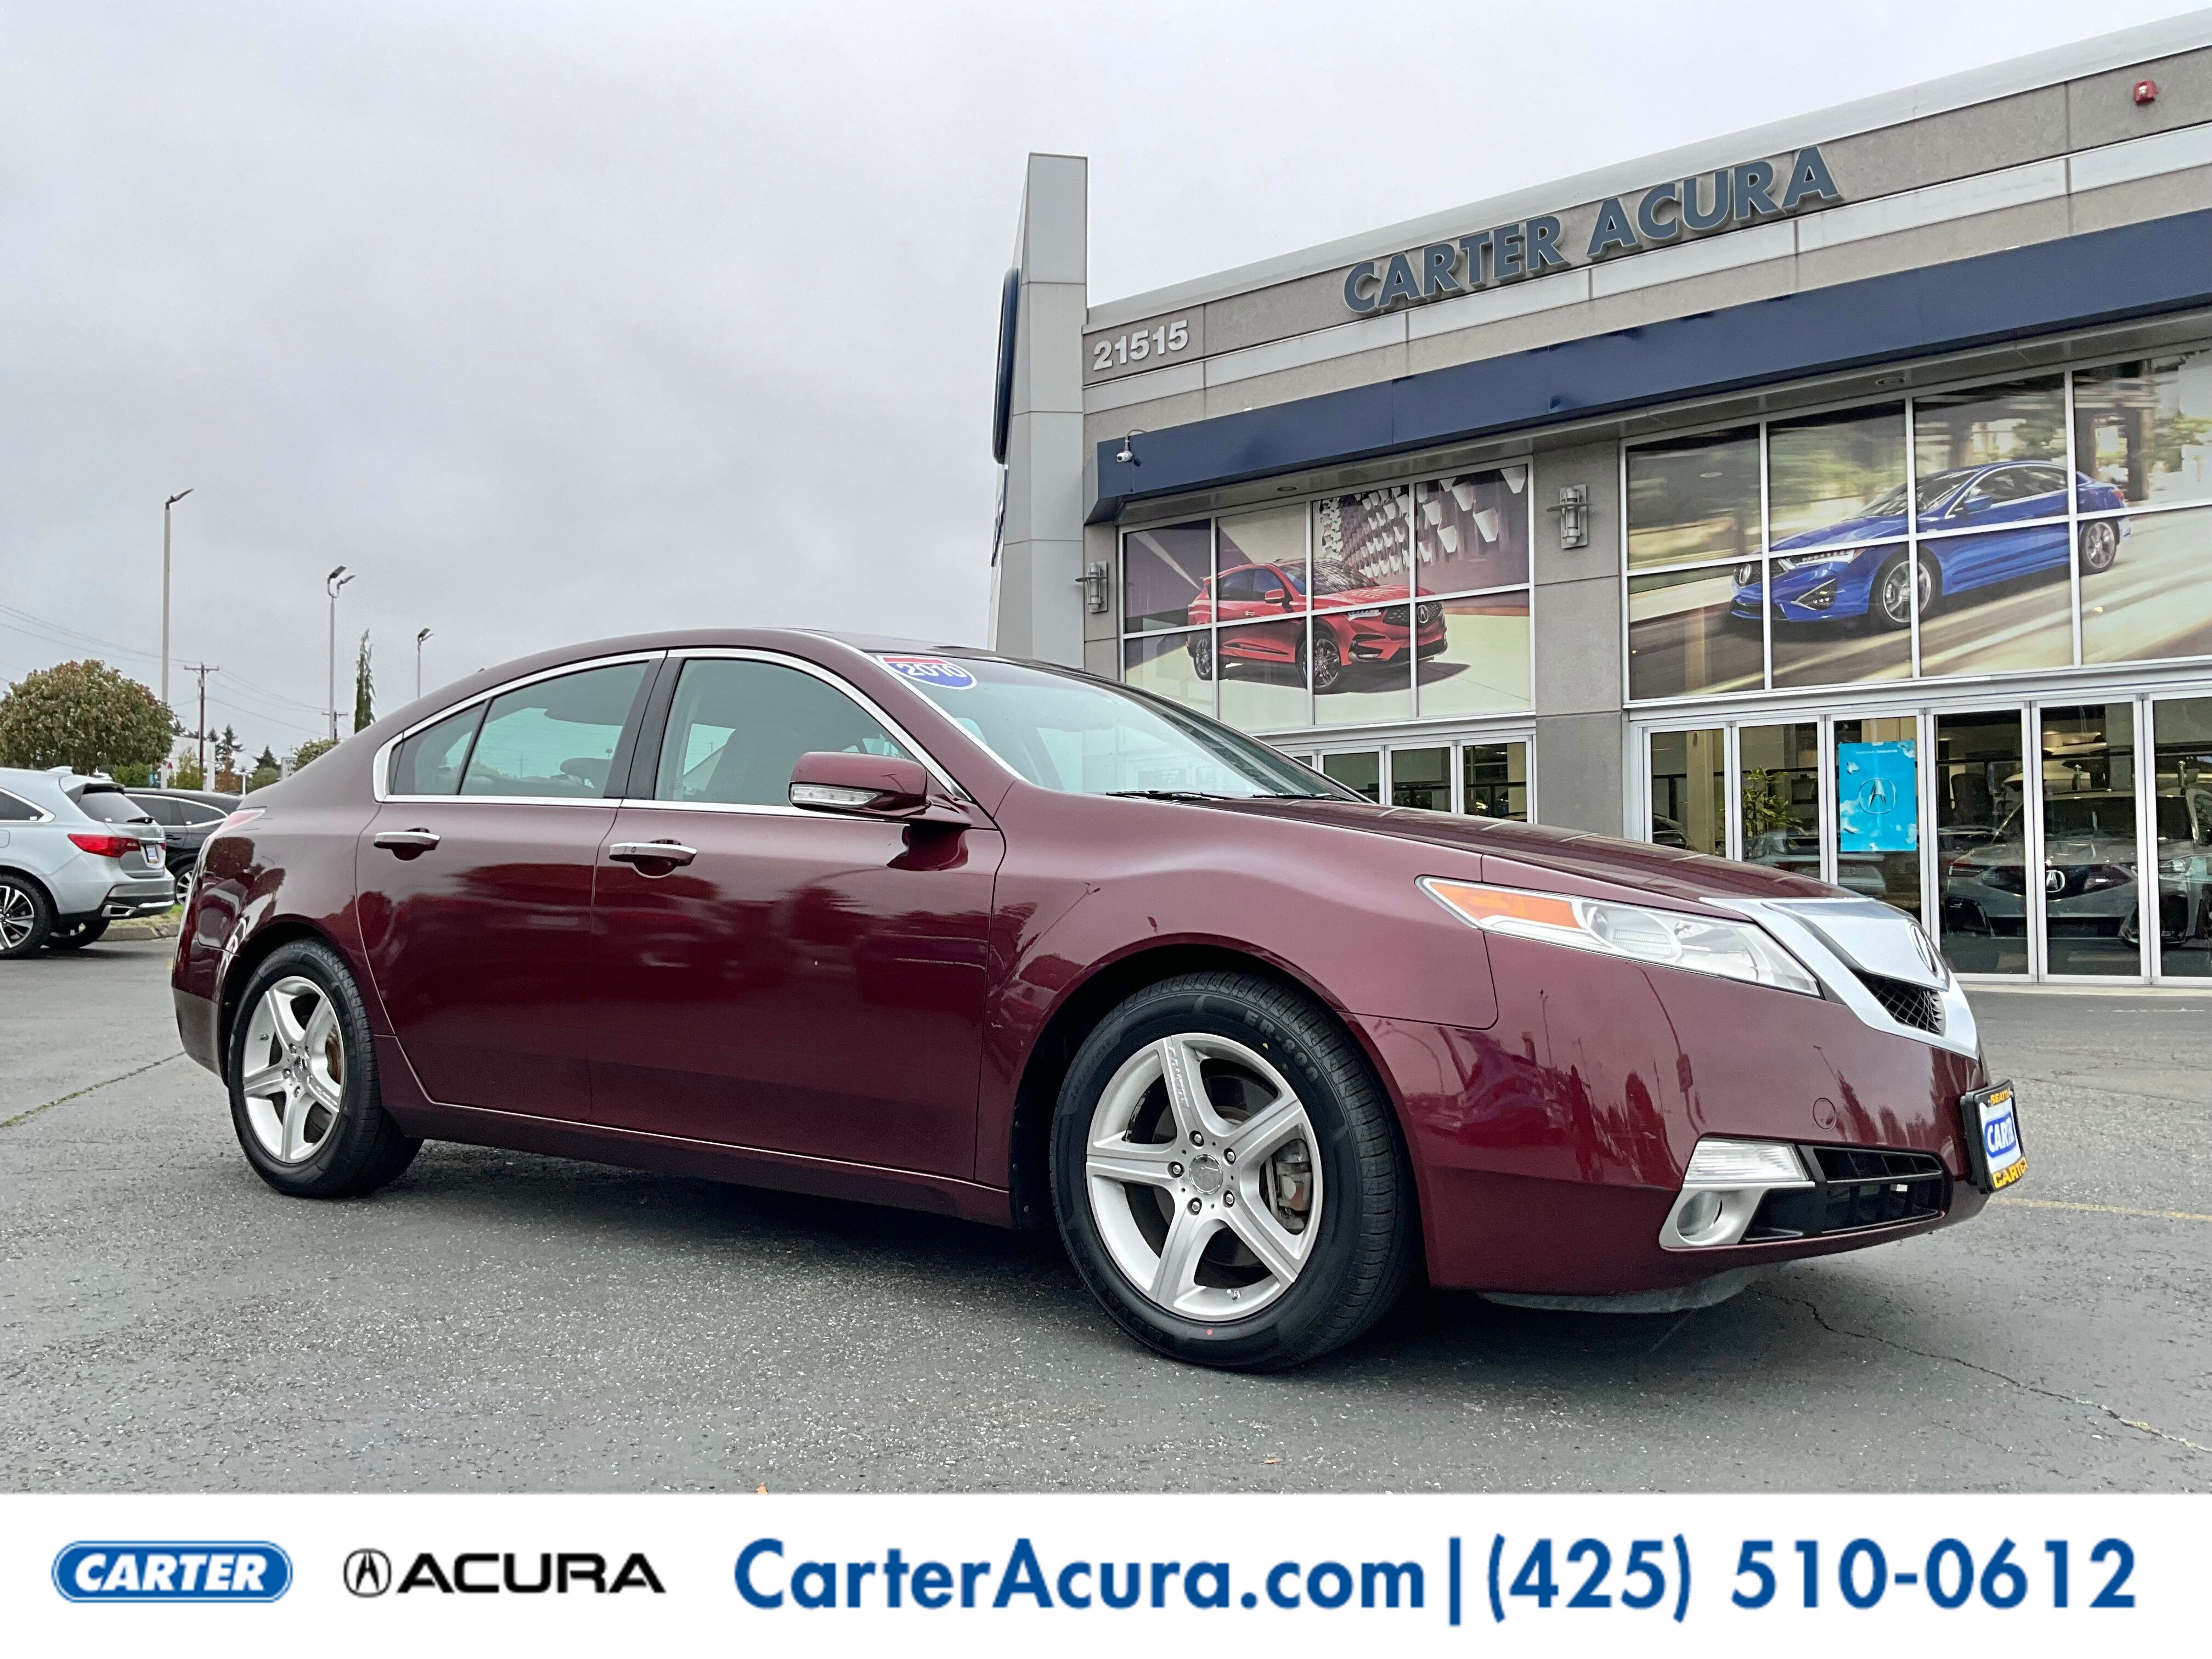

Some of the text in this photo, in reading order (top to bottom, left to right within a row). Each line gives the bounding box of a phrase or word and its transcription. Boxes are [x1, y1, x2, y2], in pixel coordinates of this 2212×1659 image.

[1344, 145, 1840, 313] CARTER ACURA
[1093, 319, 1189, 370] 21515
[896, 663, 967, 678] 2010
